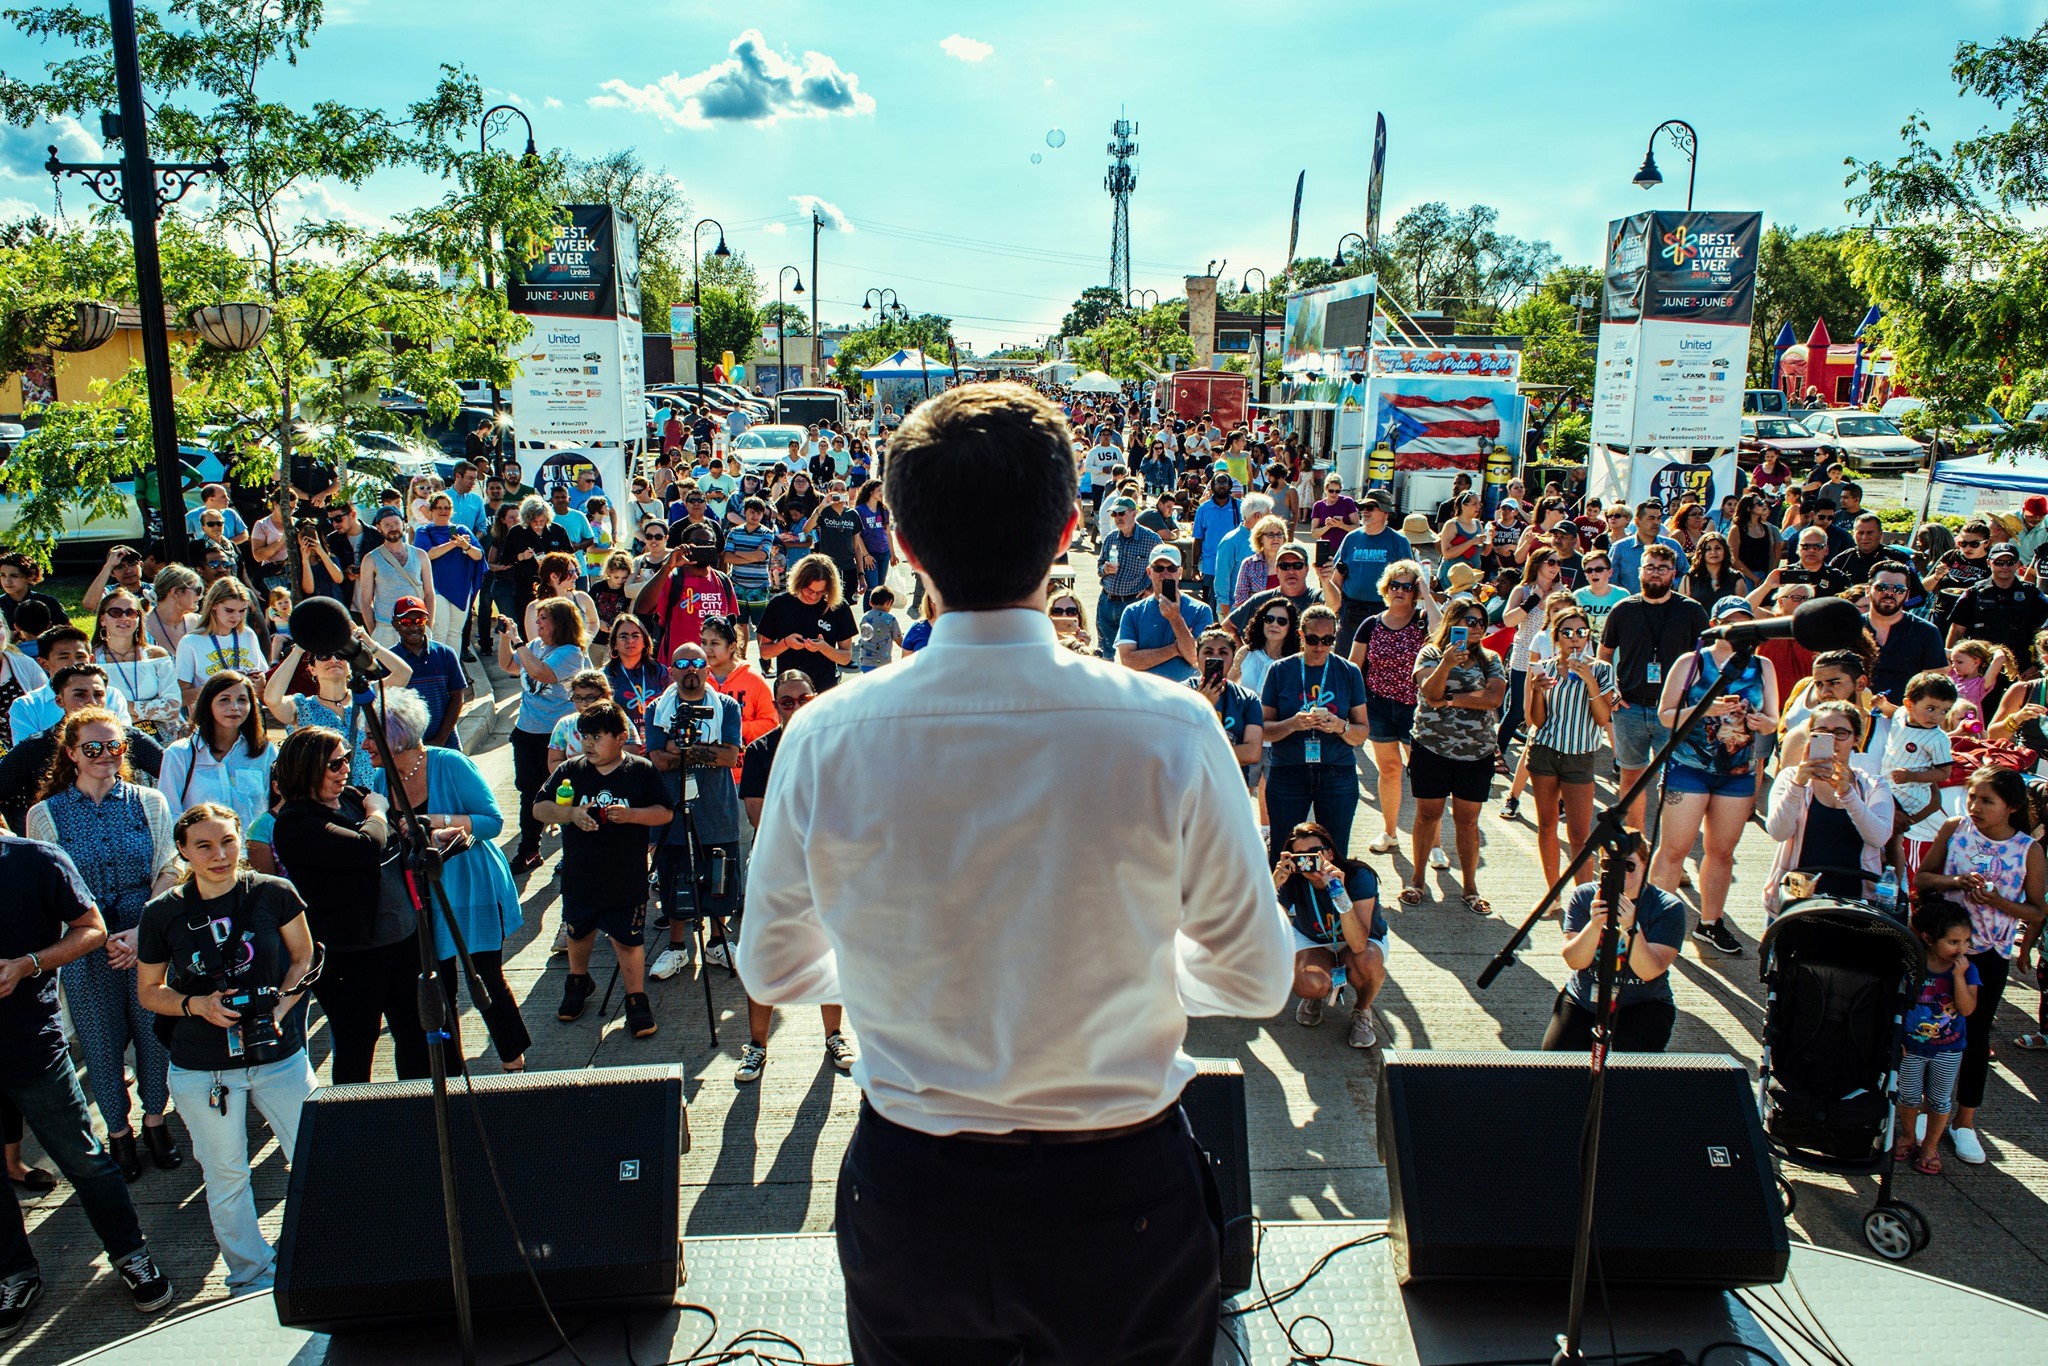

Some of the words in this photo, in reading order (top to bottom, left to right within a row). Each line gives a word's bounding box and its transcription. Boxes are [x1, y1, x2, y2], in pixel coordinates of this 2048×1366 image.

[1700, 234, 1735, 245] BEST.
[554, 239, 599, 252] WEEK.
[1701, 247, 1744, 258] WEEK.
[548, 252, 588, 265] EVER.
[1692, 260, 1730, 271] EVER.
[570, 268, 590, 276] United
[548, 334, 580, 344] United
[1680, 340, 1712, 350] United
[1410, 358, 1442, 372] Fried
[1443, 357, 1478, 371] Potato
[1481, 357, 1512, 371] Ball!
[1098, 452, 1118, 461] USA
[1353, 549, 1388, 561] MAINE
[702, 602, 723, 610] CITY
